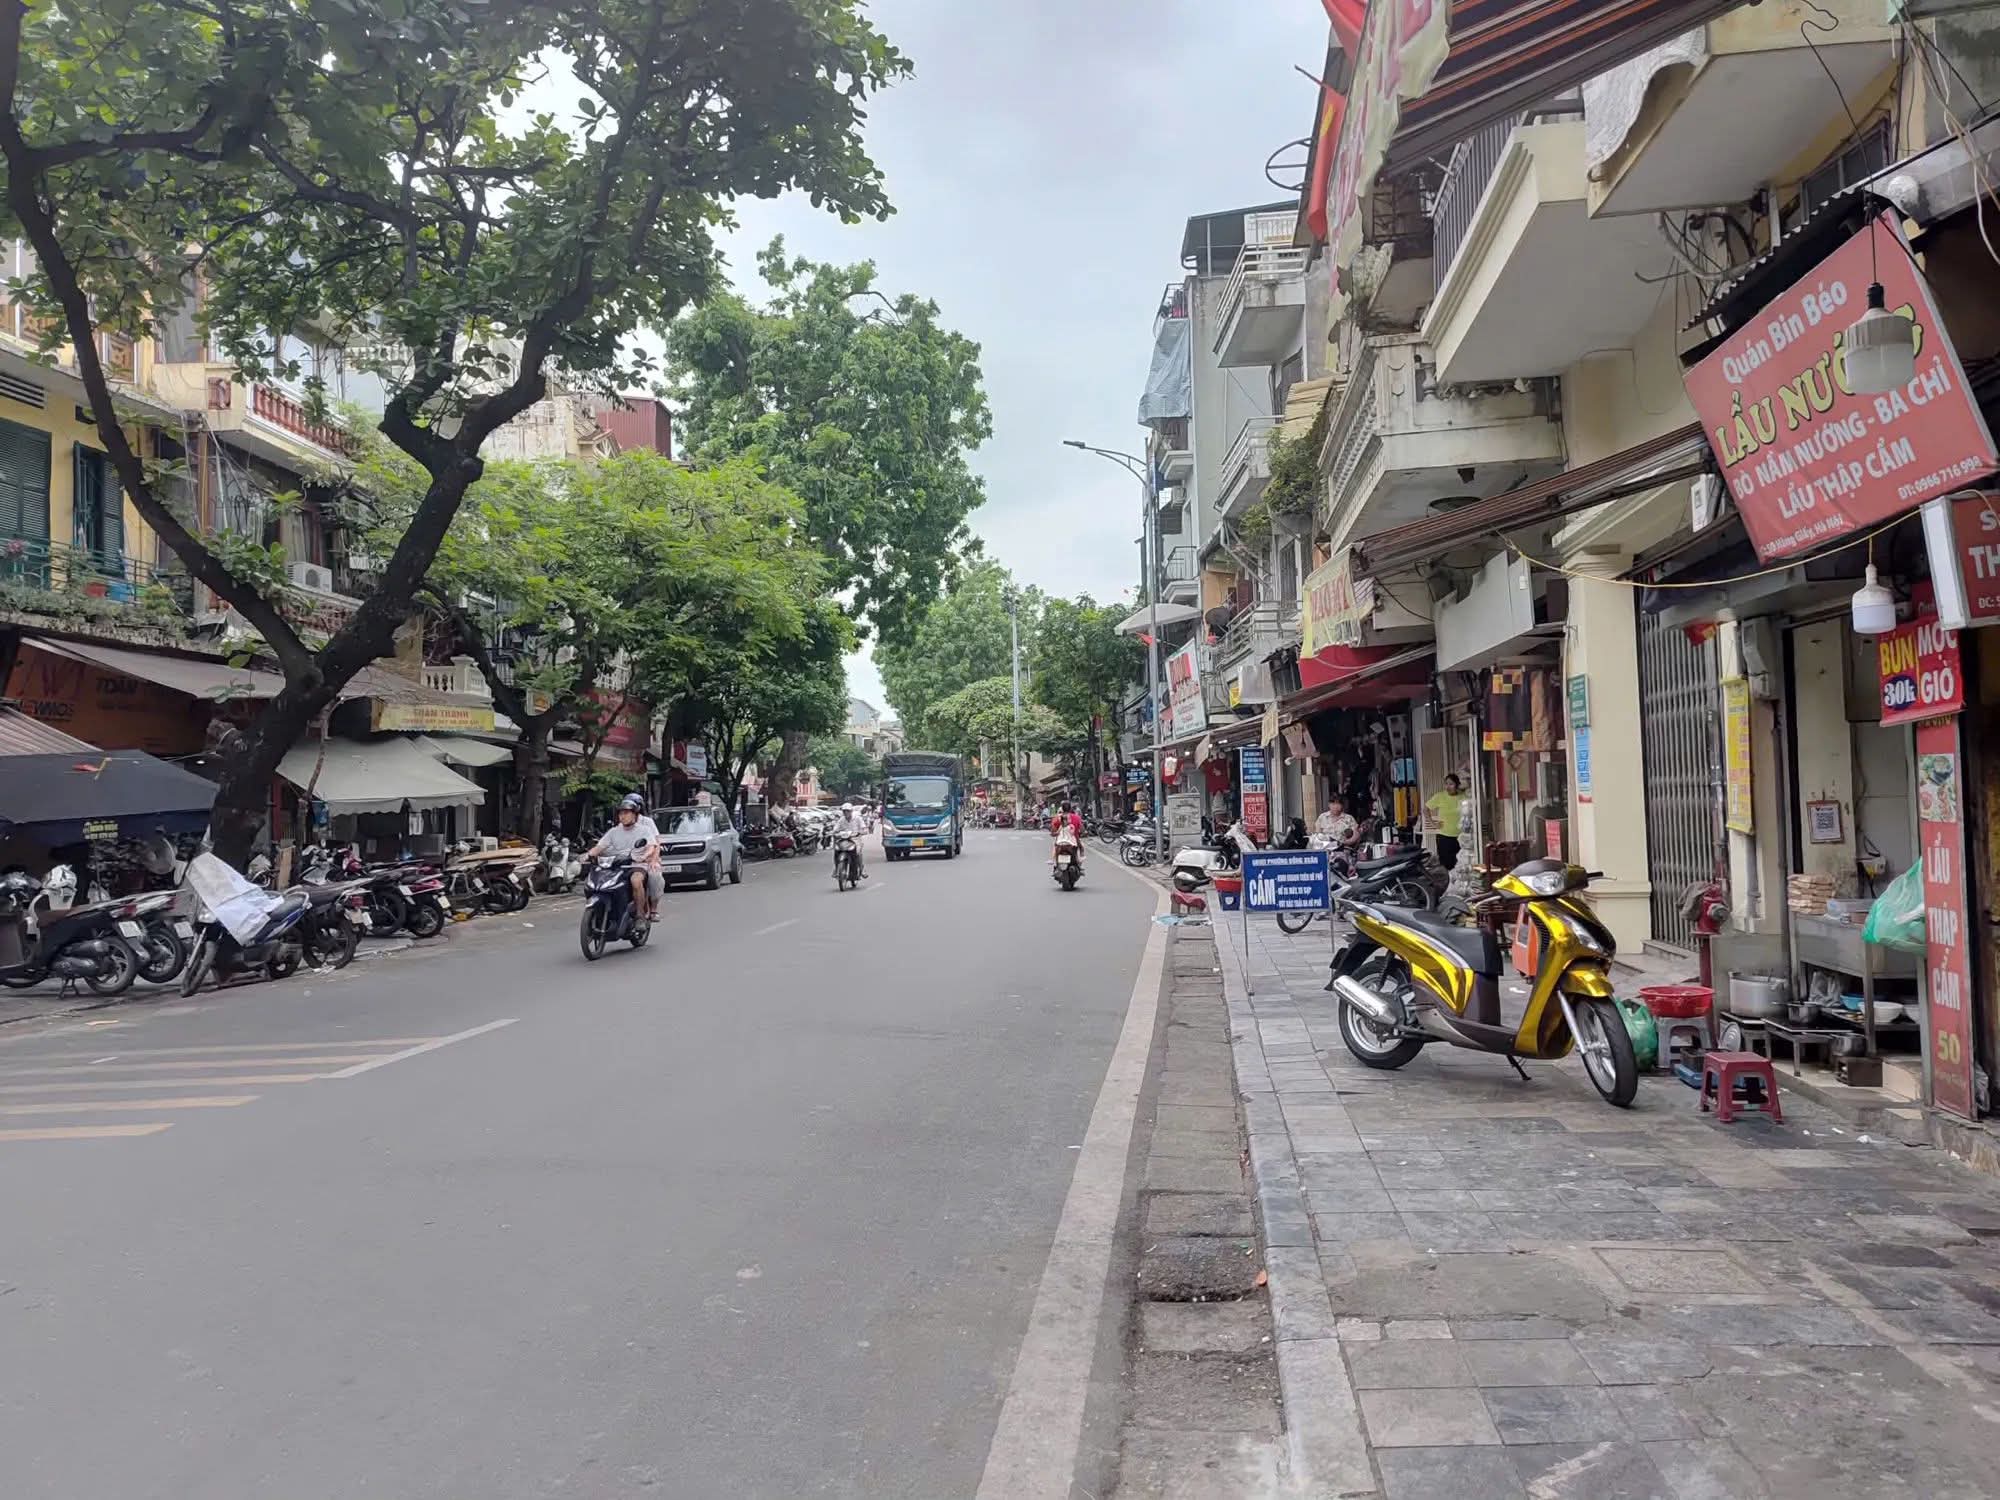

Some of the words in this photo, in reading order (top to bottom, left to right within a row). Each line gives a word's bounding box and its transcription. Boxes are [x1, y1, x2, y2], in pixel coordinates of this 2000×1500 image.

[1722, 338, 1773, 384] Quán
[1767, 313, 1805, 352] Bin
[1801, 280, 1847, 327] Béo
[1714, 389, 1777, 468] LẨU
[1732, 468, 1755, 500] BÒ
[1793, 410, 1868, 468] NƯỚNG
[1874, 389, 1910, 425] BA
[1907, 354, 1952, 406] CHỈ
[1777, 480, 1816, 519] LẨU
[1814, 461, 1864, 501] THẬP
[1865, 436, 1917, 479] CẨM
[1939, 463, 1961, 482] 716
[1879, 629, 1915, 676] BÚN
[1884, 677, 1917, 707] 30k
[1920, 659, 1955, 704] GIÒ
[1927, 831, 1951, 884] LẨU
[1249, 869, 1276, 906] CẤM
[1927, 901, 1958, 953] THẬP
[1932, 954, 1961, 1011] CẨM
[1937, 1030, 1961, 1065] 50
